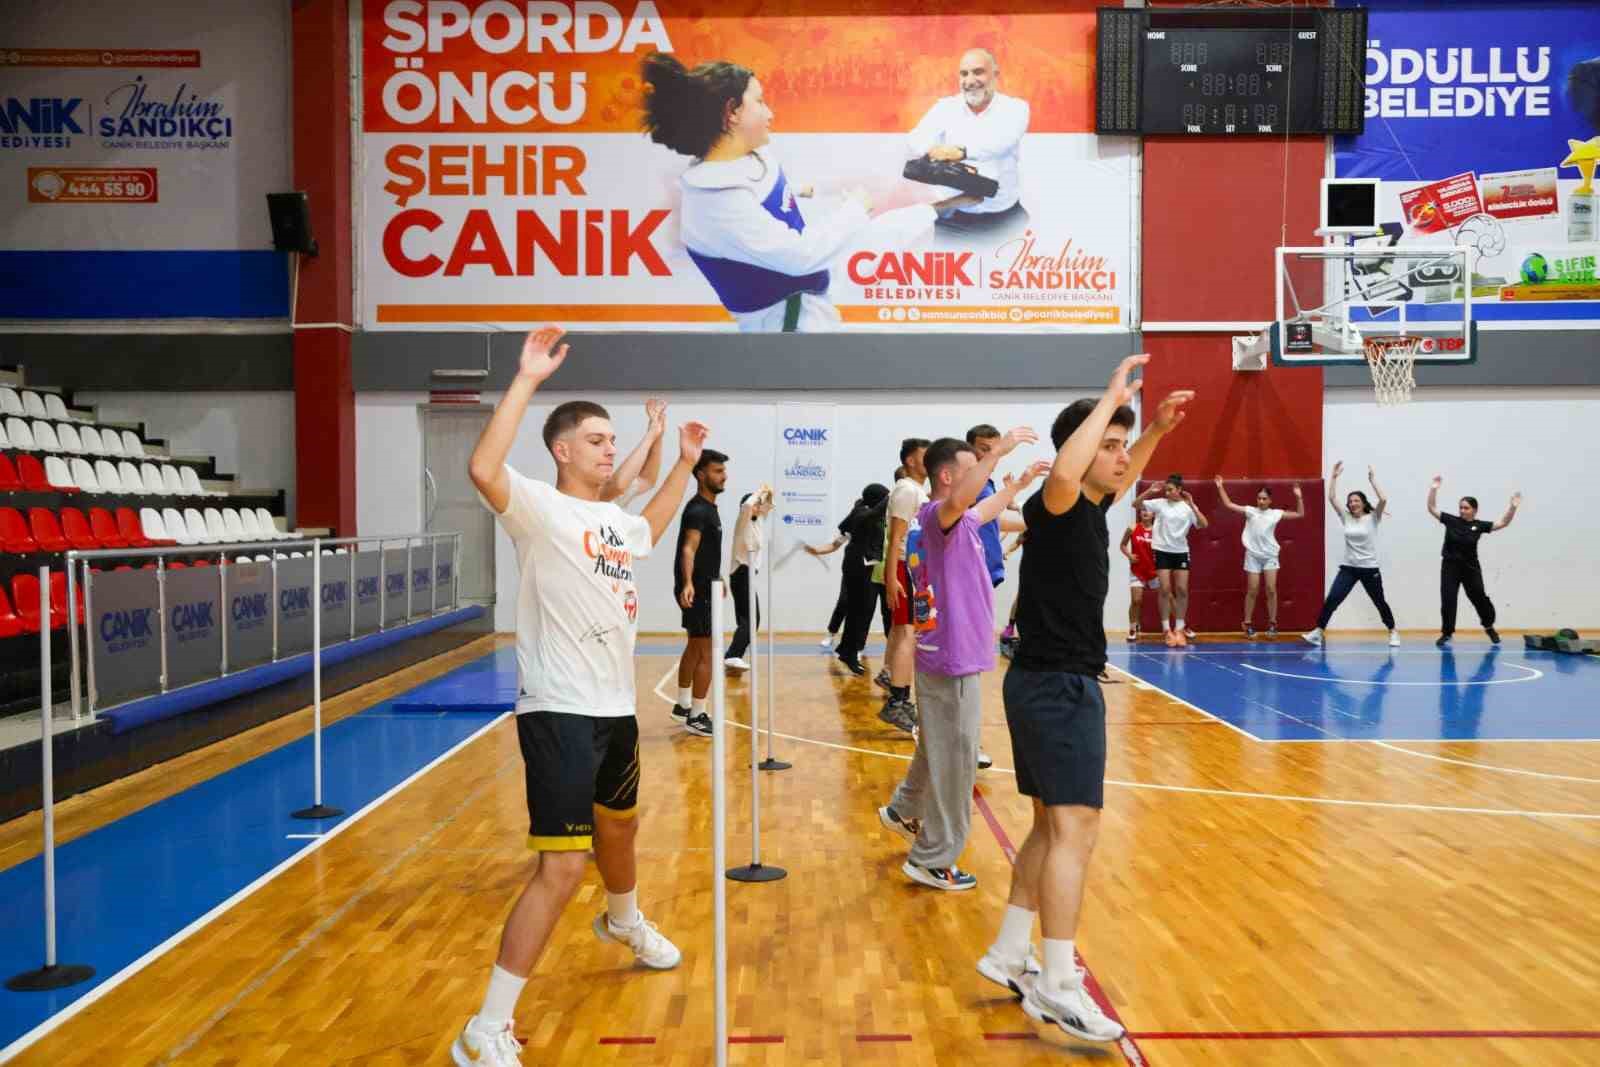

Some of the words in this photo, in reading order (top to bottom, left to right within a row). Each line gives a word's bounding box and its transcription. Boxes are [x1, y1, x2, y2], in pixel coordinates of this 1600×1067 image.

[381, 0, 674, 53] SPORDA
[1147, 32, 1165, 40] HOME
[1298, 31, 1317, 39] GUEST
[1181, 64, 1197, 72] SCORE
[1266, 64, 1282, 72] SCORE
[382, 57, 587, 125] ÖNCÜ
[100, 118, 232, 140] SANDIKÇI
[68, 182, 100, 196] 444
[104, 182, 123, 196] 55
[126, 182, 145, 196] 90
[988, 270, 1116, 292] SANDIKÇI
